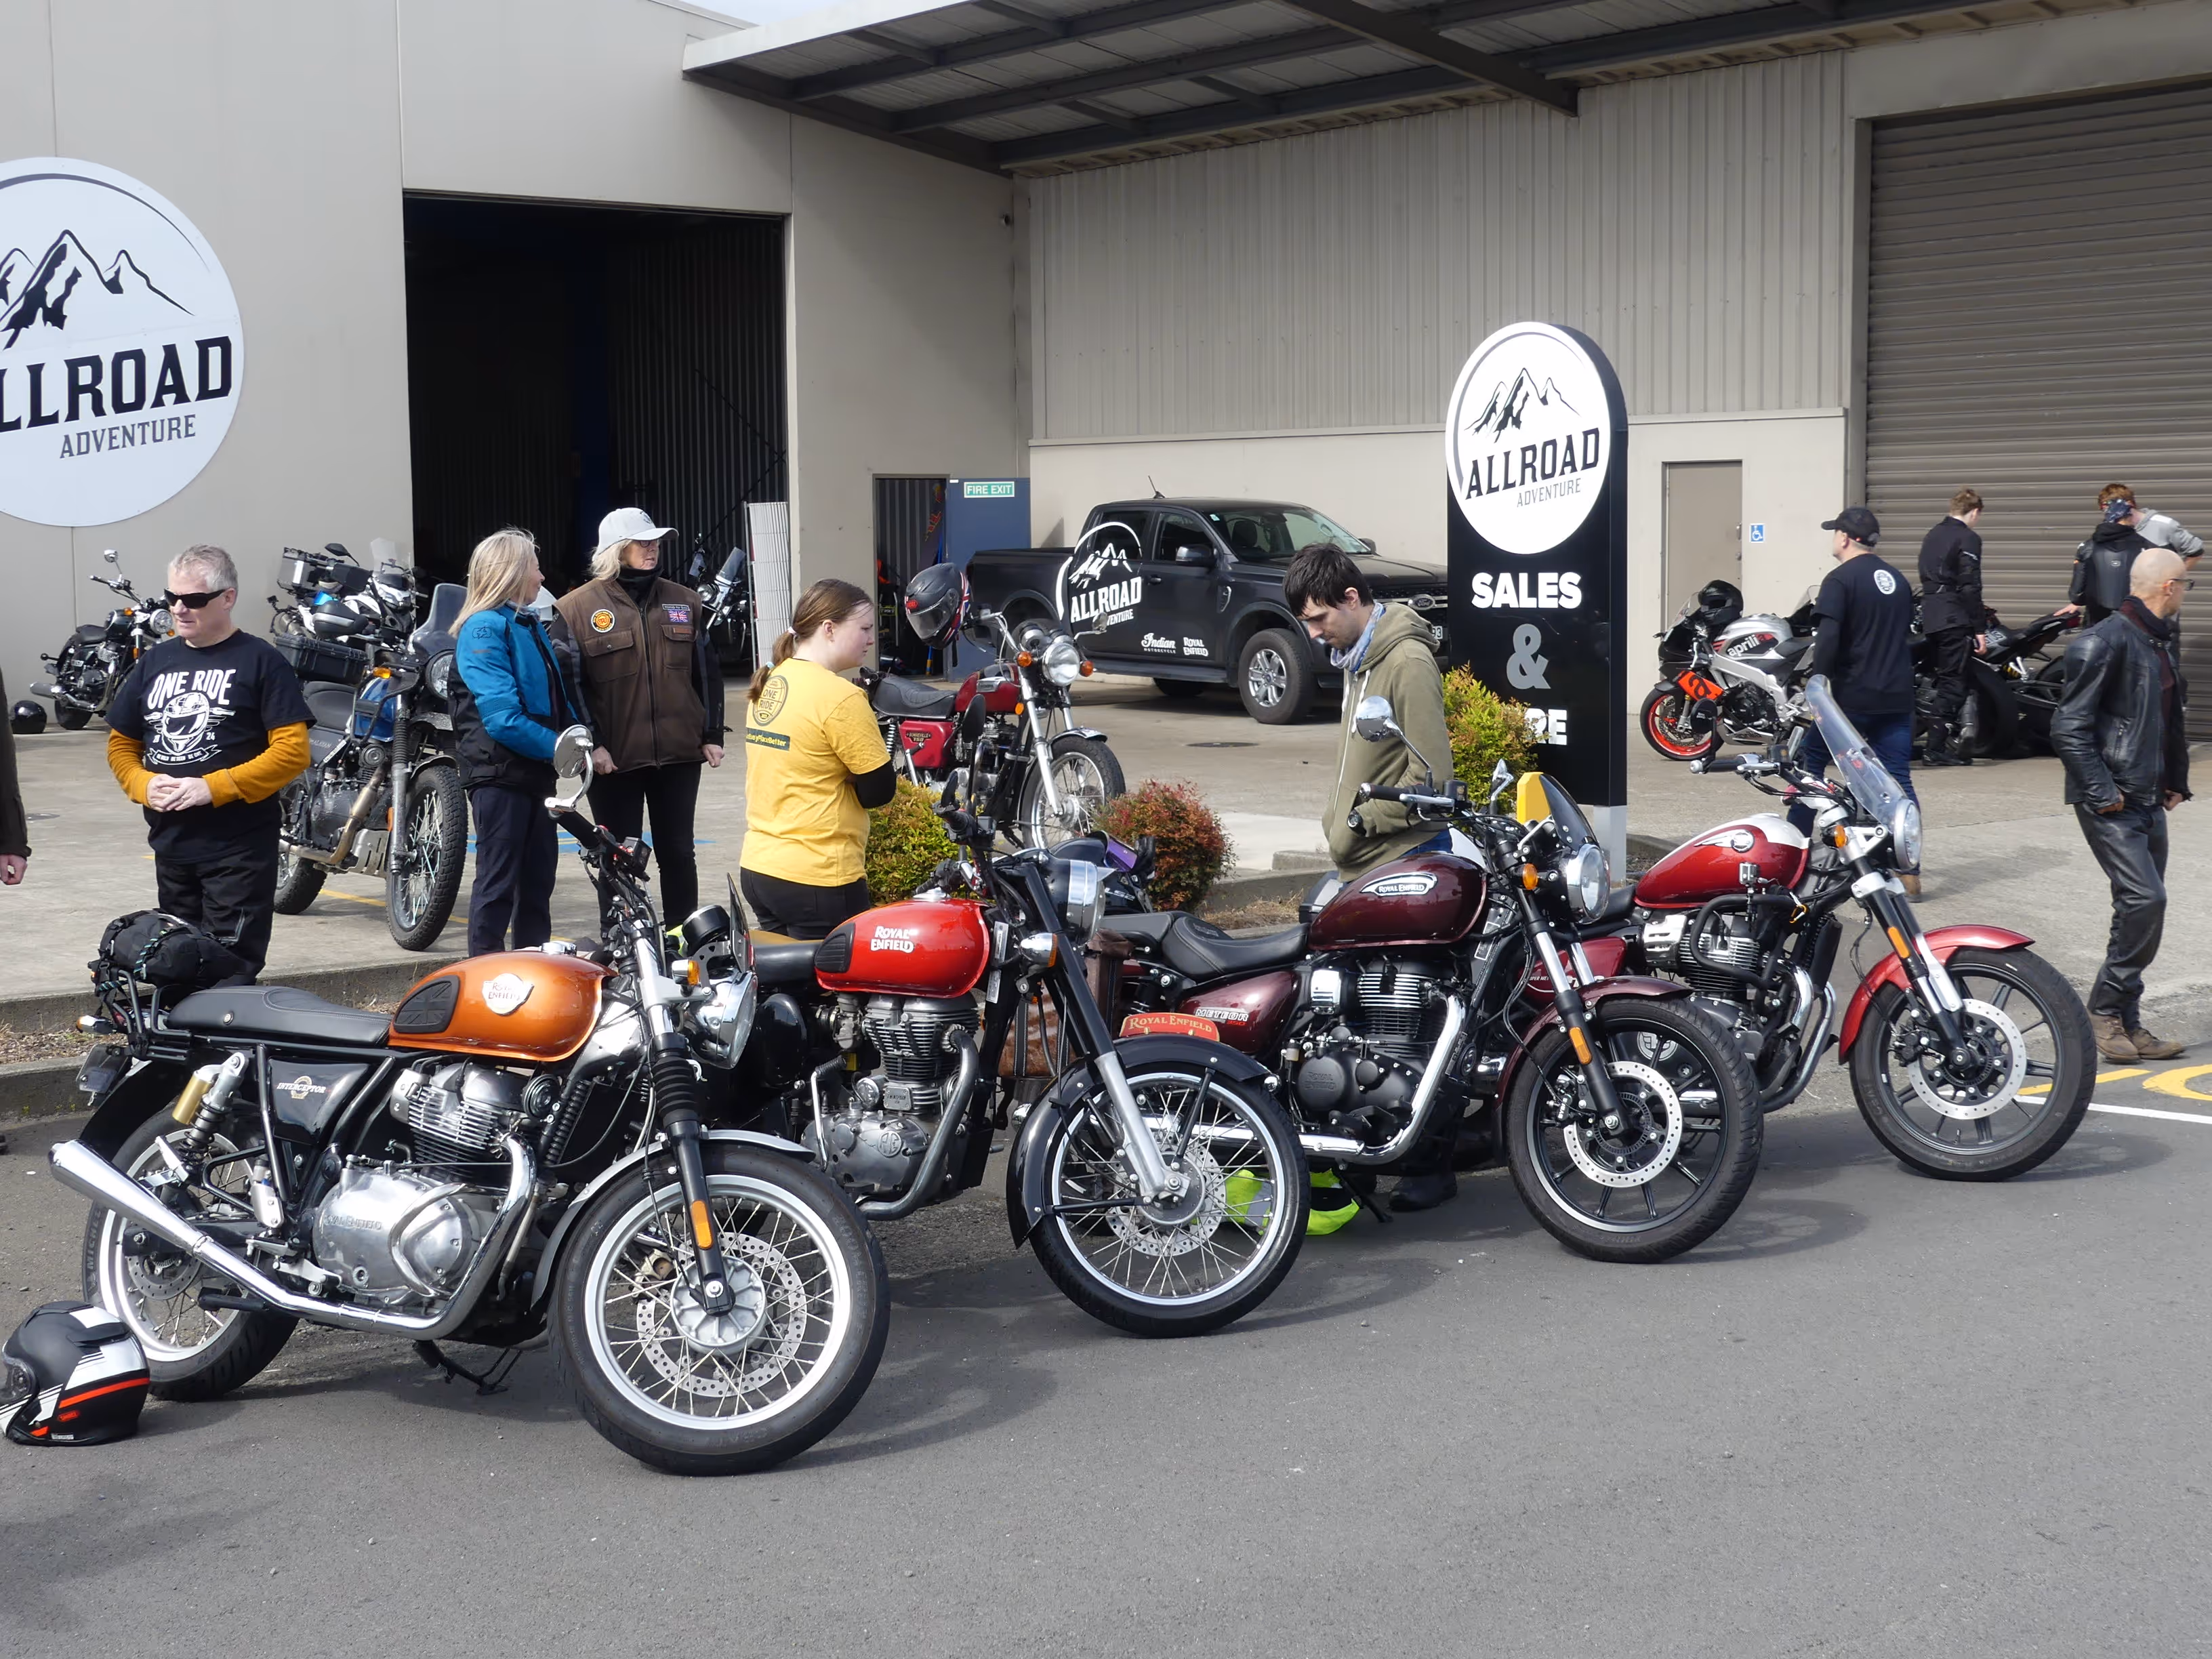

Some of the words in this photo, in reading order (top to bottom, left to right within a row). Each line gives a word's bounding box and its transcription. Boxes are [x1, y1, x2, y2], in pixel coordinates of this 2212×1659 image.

[0, 335, 232, 432] LLROAD
[60, 414, 196, 459] ADVENTURE
[1465, 428, 1599, 500] ALLROAD
[967, 485, 987, 495] FIRE
[991, 485, 1012, 494] EXIT
[1517, 478, 1581, 508] ADVENTURE
[1471, 572, 1582, 609] SALES
[1071, 576, 1142, 623] ALLROAD
[1107, 609, 1134, 626] VENTURE
[1141, 633, 1176, 649] Indian
[1183, 637, 1204, 647] ROYAL
[1183, 647, 1208, 657] ENFIELD
[1507, 623, 1551, 689] &
[148, 672, 189, 710] ONE
[192, 669, 236, 705] RIDE
[763, 689, 778, 699] ONE
[759, 700, 774, 711] RIDE
[1524, 708, 1568, 745] RE
[206, 732, 216, 740] 24
[1399, 884, 1425, 892] ENFIELD
[875, 926, 909, 939] ROYAL
[871, 939, 914, 954] ENFIELD
[1195, 1008, 1249, 1022] METEOR
[1129, 1017, 1167, 1029] ROYAL
[1169, 1015, 1212, 1033] ENFIELD
[276, 1082, 327, 1093] INTERCEPTOR
